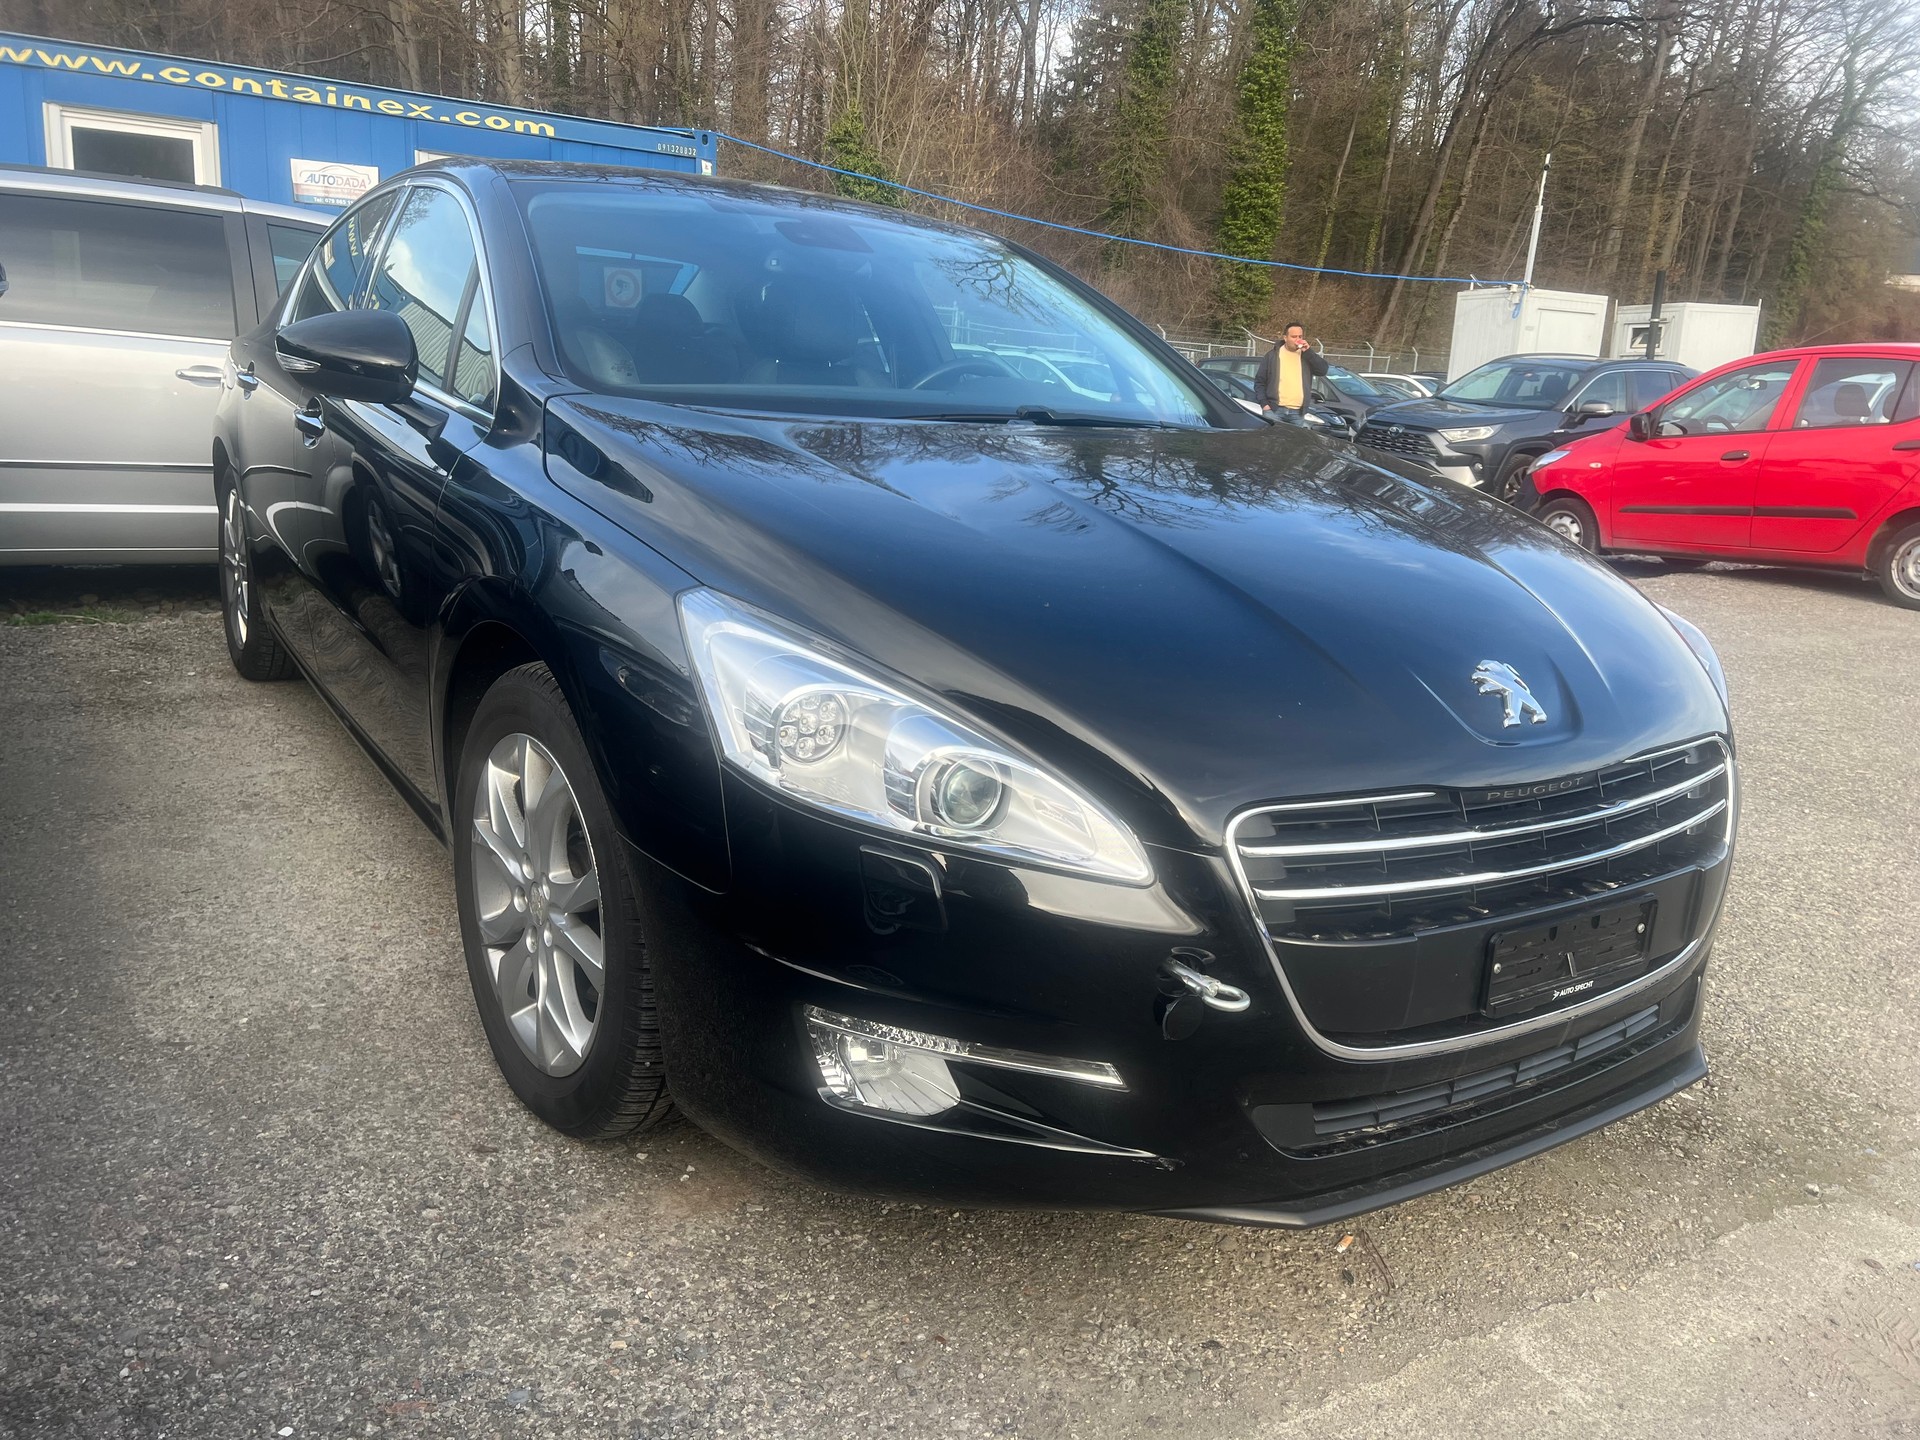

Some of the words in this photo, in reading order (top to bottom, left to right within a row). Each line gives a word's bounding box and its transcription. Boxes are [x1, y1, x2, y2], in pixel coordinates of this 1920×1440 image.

[0, 46, 555, 137] www.containex.com
[304, 173, 367, 189] AUTODADA
[1487, 776, 1584, 801] PEUGEOT
[1559, 986, 1575, 997] AUTO
[1574, 980, 1594, 993] SPECHT
